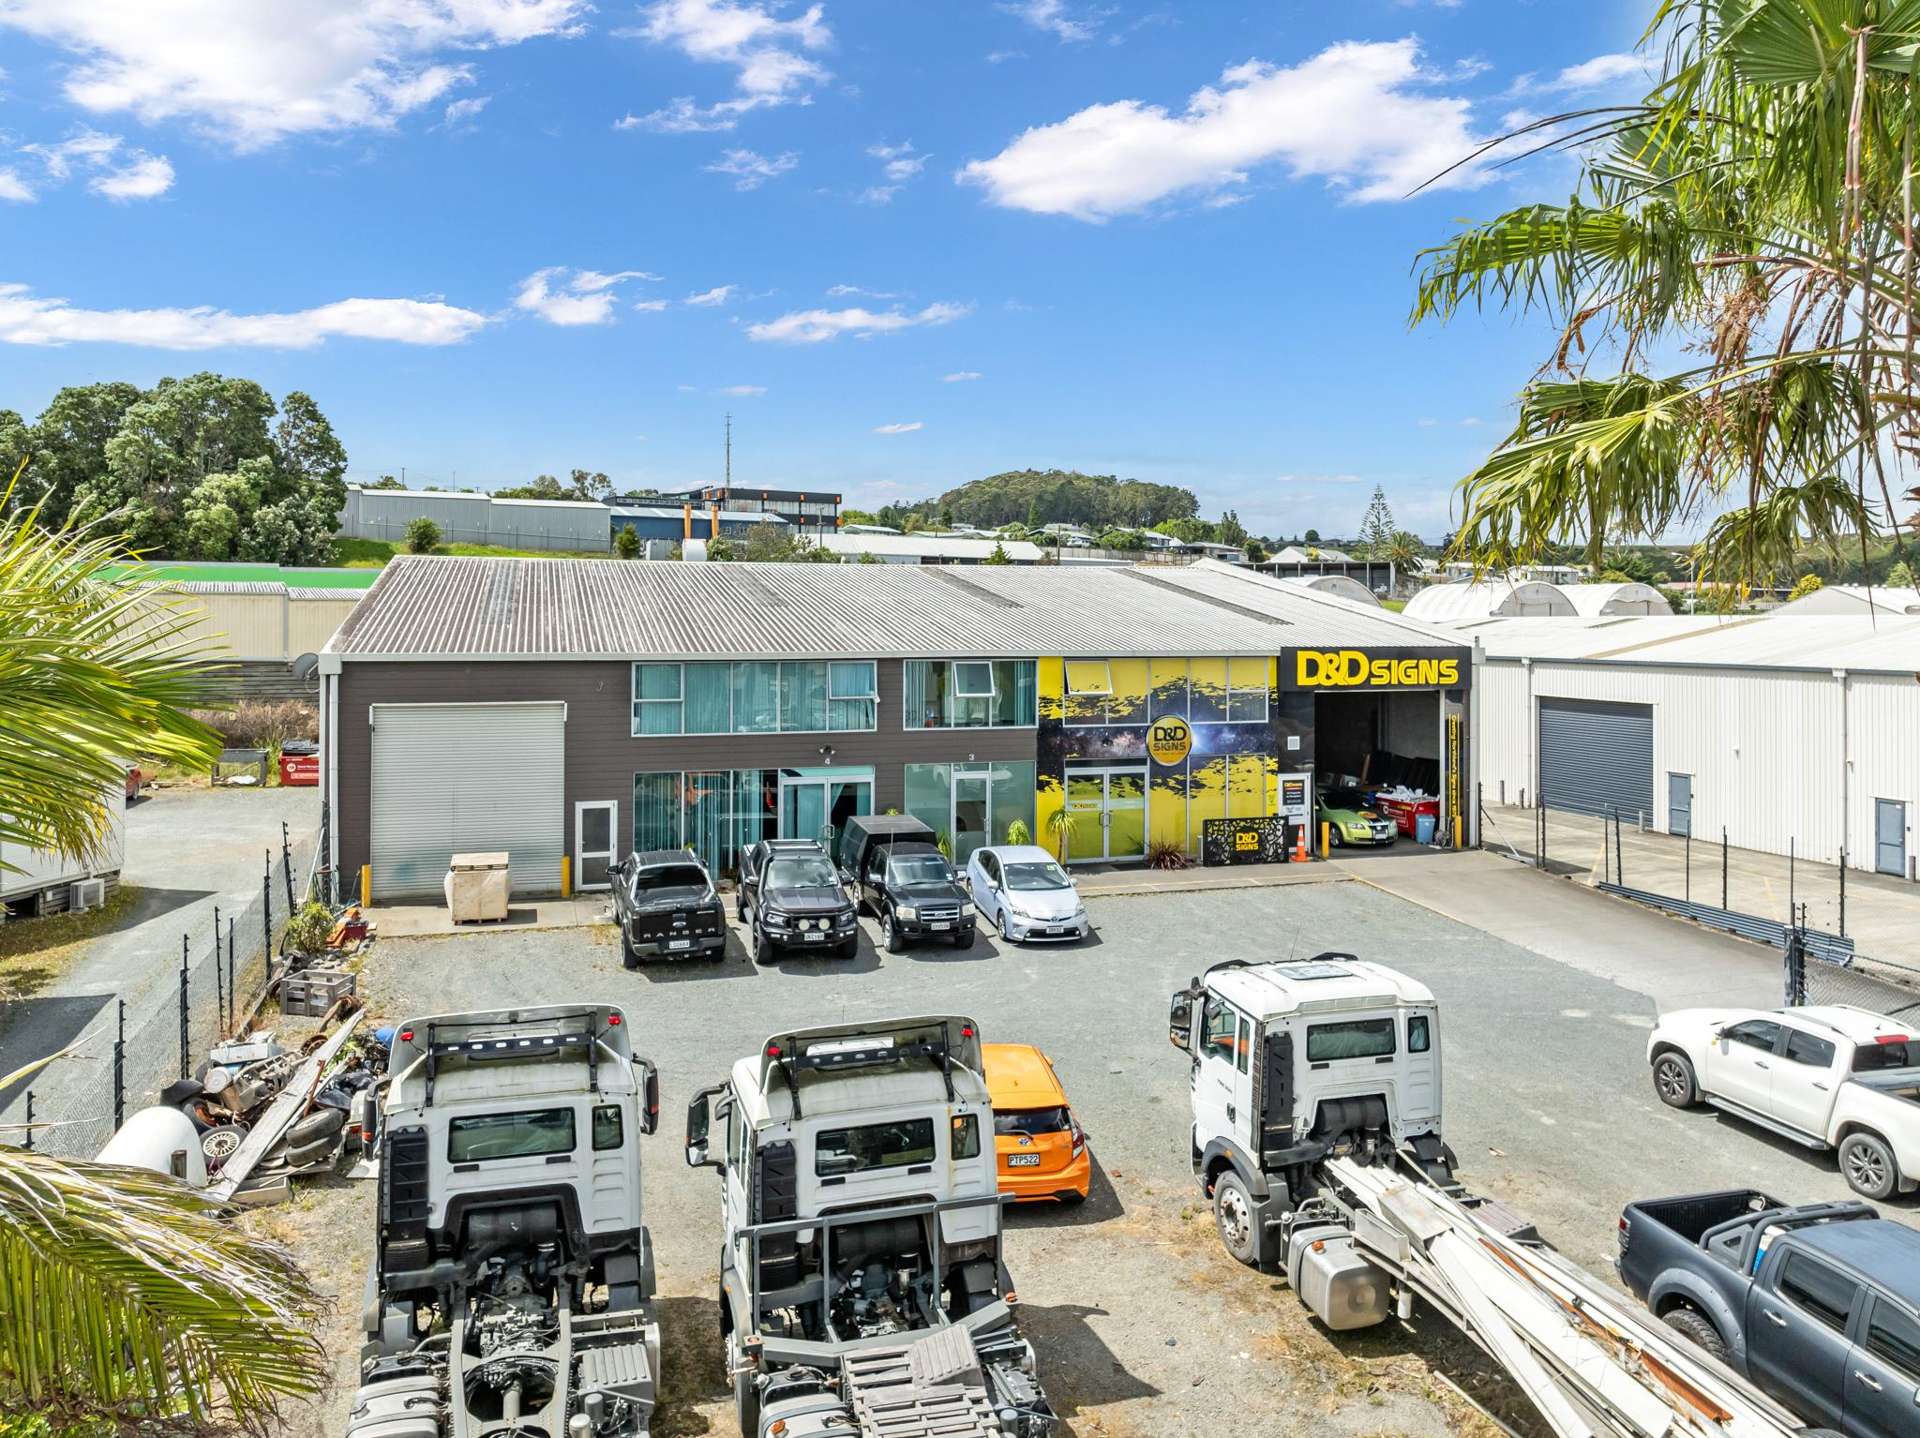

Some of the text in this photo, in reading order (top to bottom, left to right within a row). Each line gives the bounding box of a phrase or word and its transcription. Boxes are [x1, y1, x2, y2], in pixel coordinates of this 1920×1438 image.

[1297, 651, 1459, 686] D&D SIGNS
[1154, 726, 1187, 741] D&D
[1153, 742, 1186, 751] SIGNS
[1236, 832, 1258, 844] D&D
[1009, 1155, 1038, 1164] PTP522
